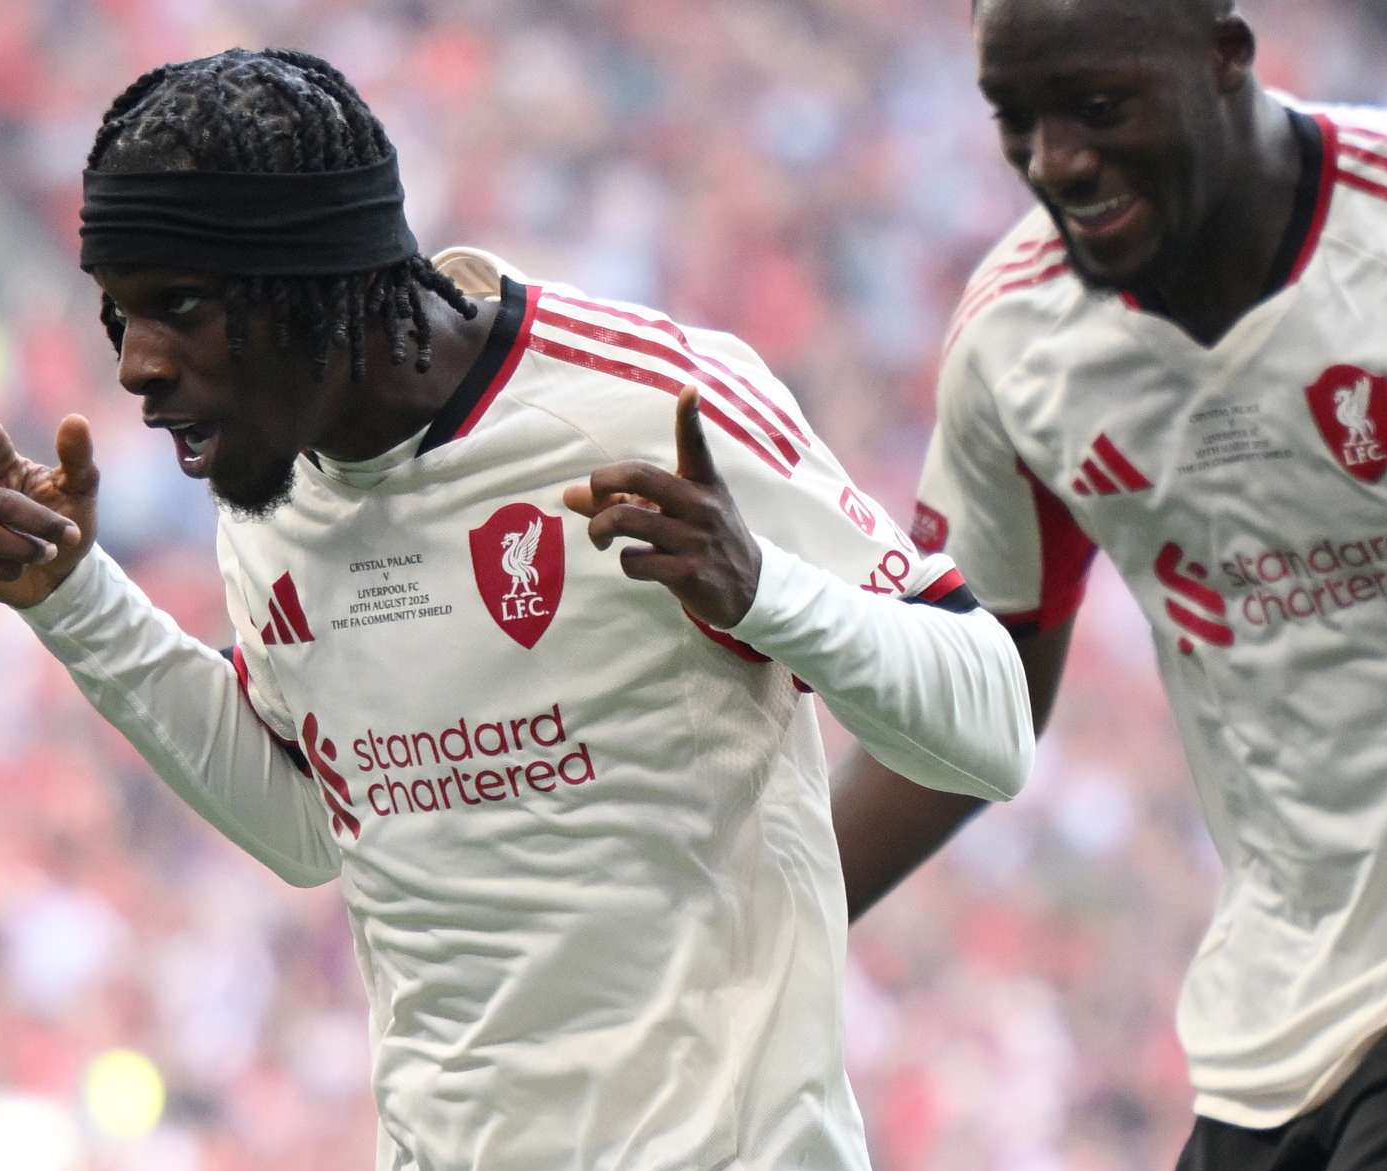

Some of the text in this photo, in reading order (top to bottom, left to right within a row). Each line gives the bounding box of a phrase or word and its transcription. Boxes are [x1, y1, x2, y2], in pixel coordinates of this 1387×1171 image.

[349, 553, 423, 573] CRYSTAL PALACE
[382, 571, 390, 581] V
[357, 581, 420, 600] LIVERPOOL FC
[349, 594, 430, 615] 10TH AUGUST 2025
[331, 604, 453, 631] THE FA COMMUNITY SHIELD
[352, 702, 567, 773] standard
[366, 742, 597, 818] chartered
